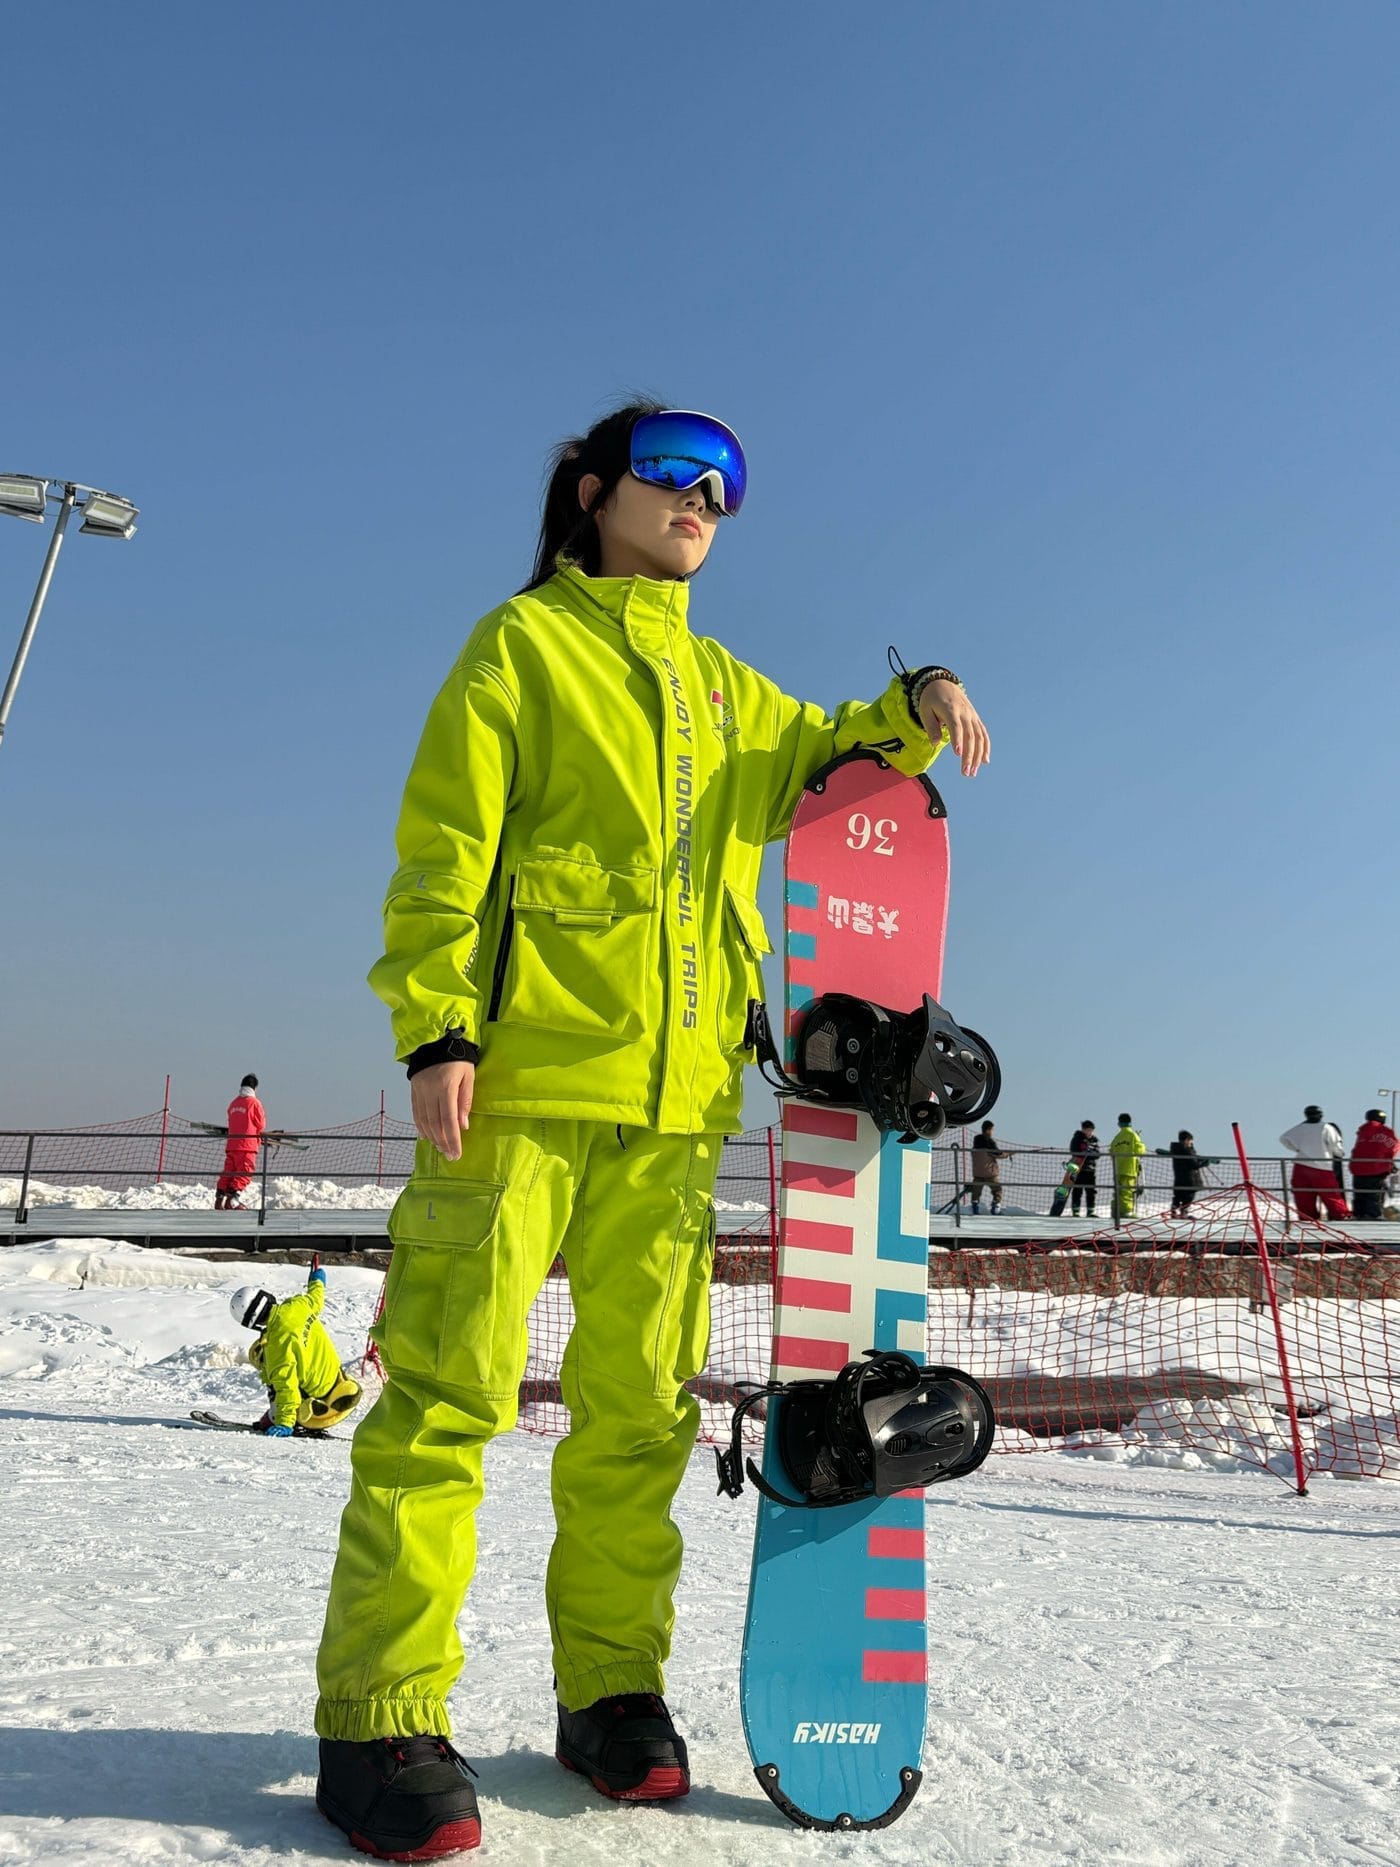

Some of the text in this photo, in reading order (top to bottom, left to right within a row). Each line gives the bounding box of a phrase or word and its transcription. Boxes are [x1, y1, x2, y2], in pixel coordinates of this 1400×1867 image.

[662, 657, 697, 1028] ENJOY WONDERFUL TRIPS
[846, 812, 898, 857] 36
[427, 1201, 437, 1220] L
[792, 1722, 882, 1744] HASIKY
